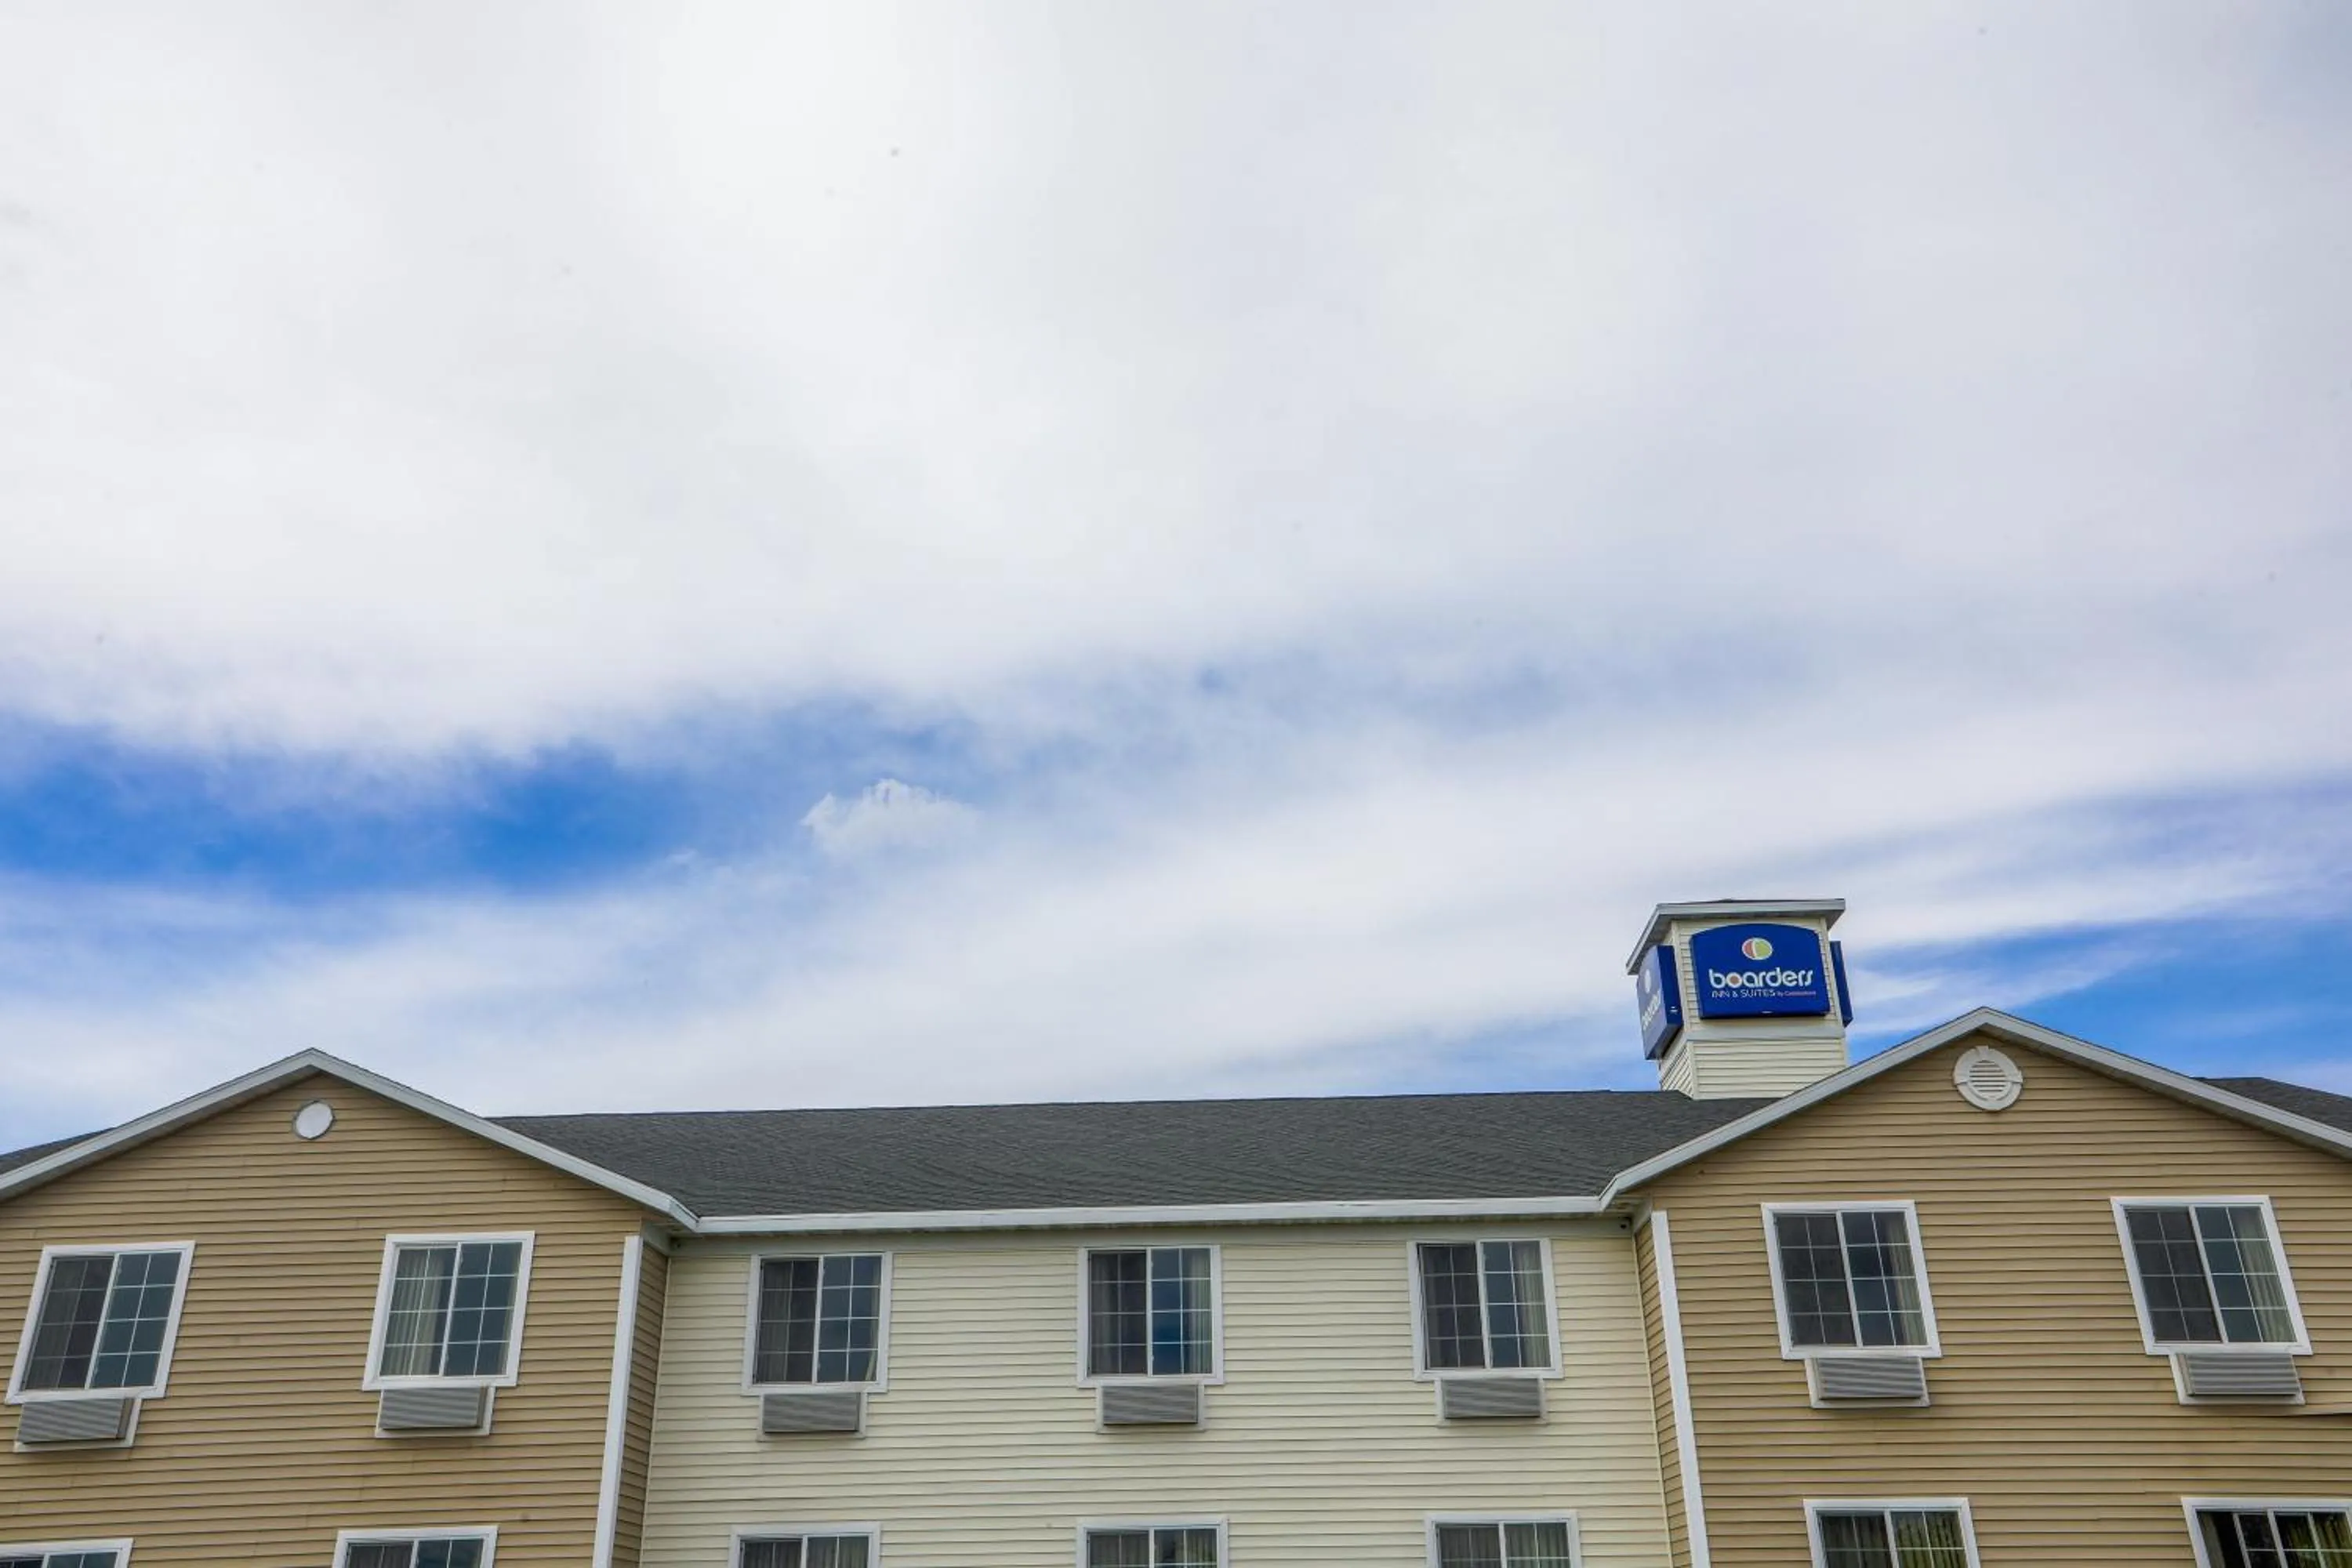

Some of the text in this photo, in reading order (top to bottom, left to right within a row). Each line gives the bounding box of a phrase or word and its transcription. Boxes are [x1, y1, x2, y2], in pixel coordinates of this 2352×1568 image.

[1708, 967, 1813, 989] boarders
[1711, 989, 1730, 998] INN
[1733, 989, 1738, 998] &
[1740, 988, 1776, 998] SUITES
